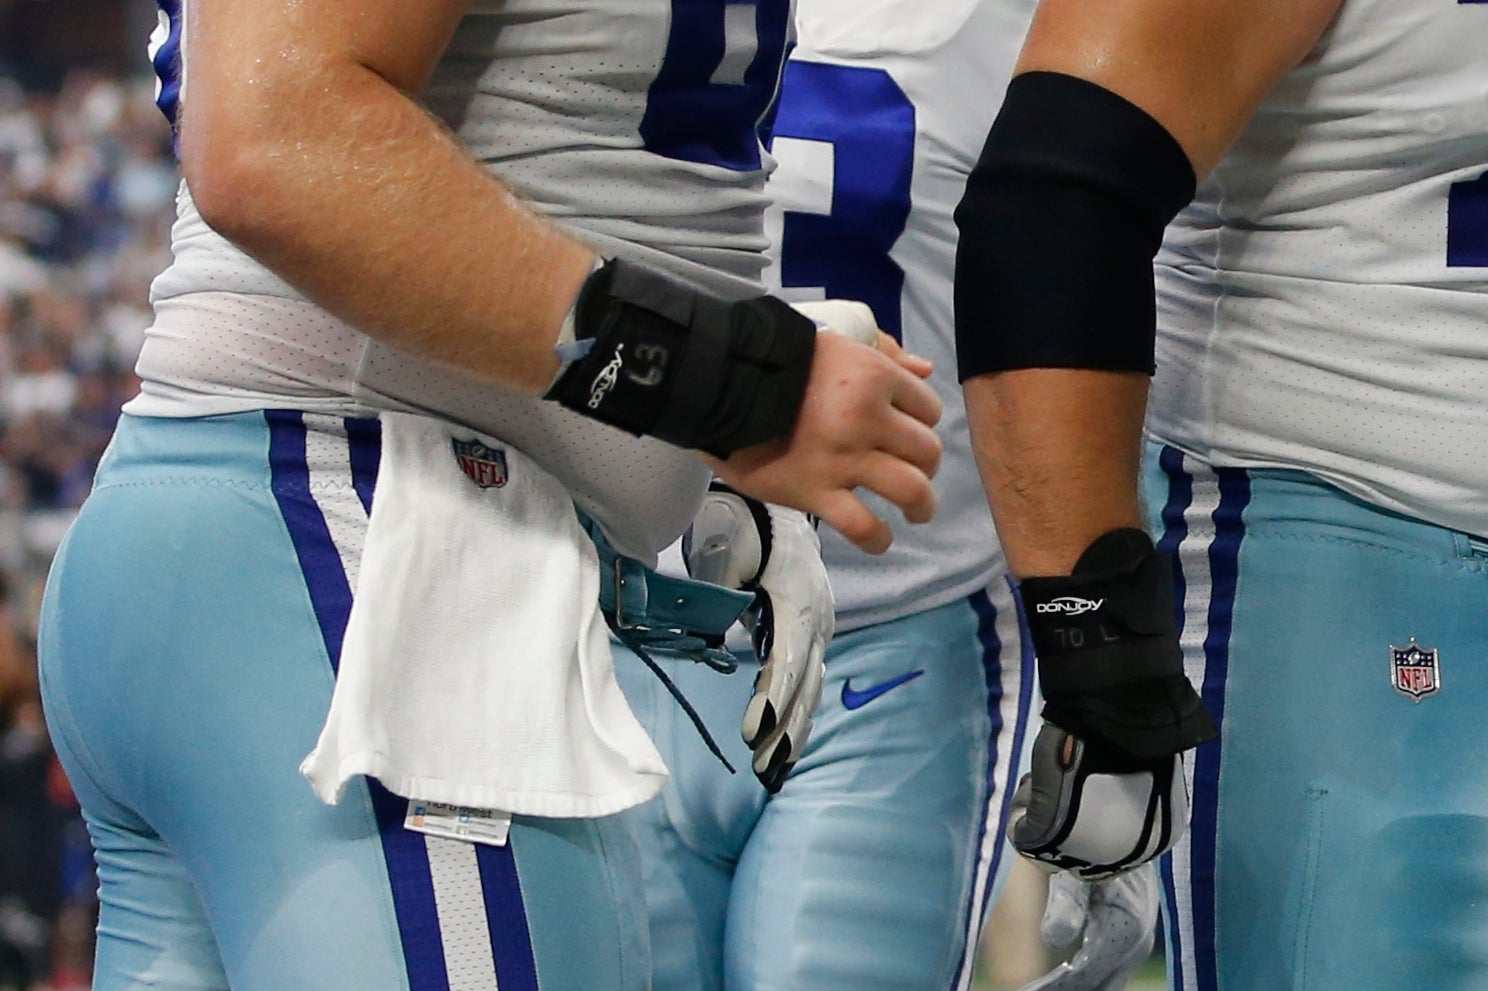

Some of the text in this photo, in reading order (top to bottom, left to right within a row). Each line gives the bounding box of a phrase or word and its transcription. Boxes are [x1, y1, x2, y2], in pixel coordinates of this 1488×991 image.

[461, 457, 504, 485] NFL
[1036, 596, 1104, 616] DONJOY
[1399, 667, 1433, 692] NFL
